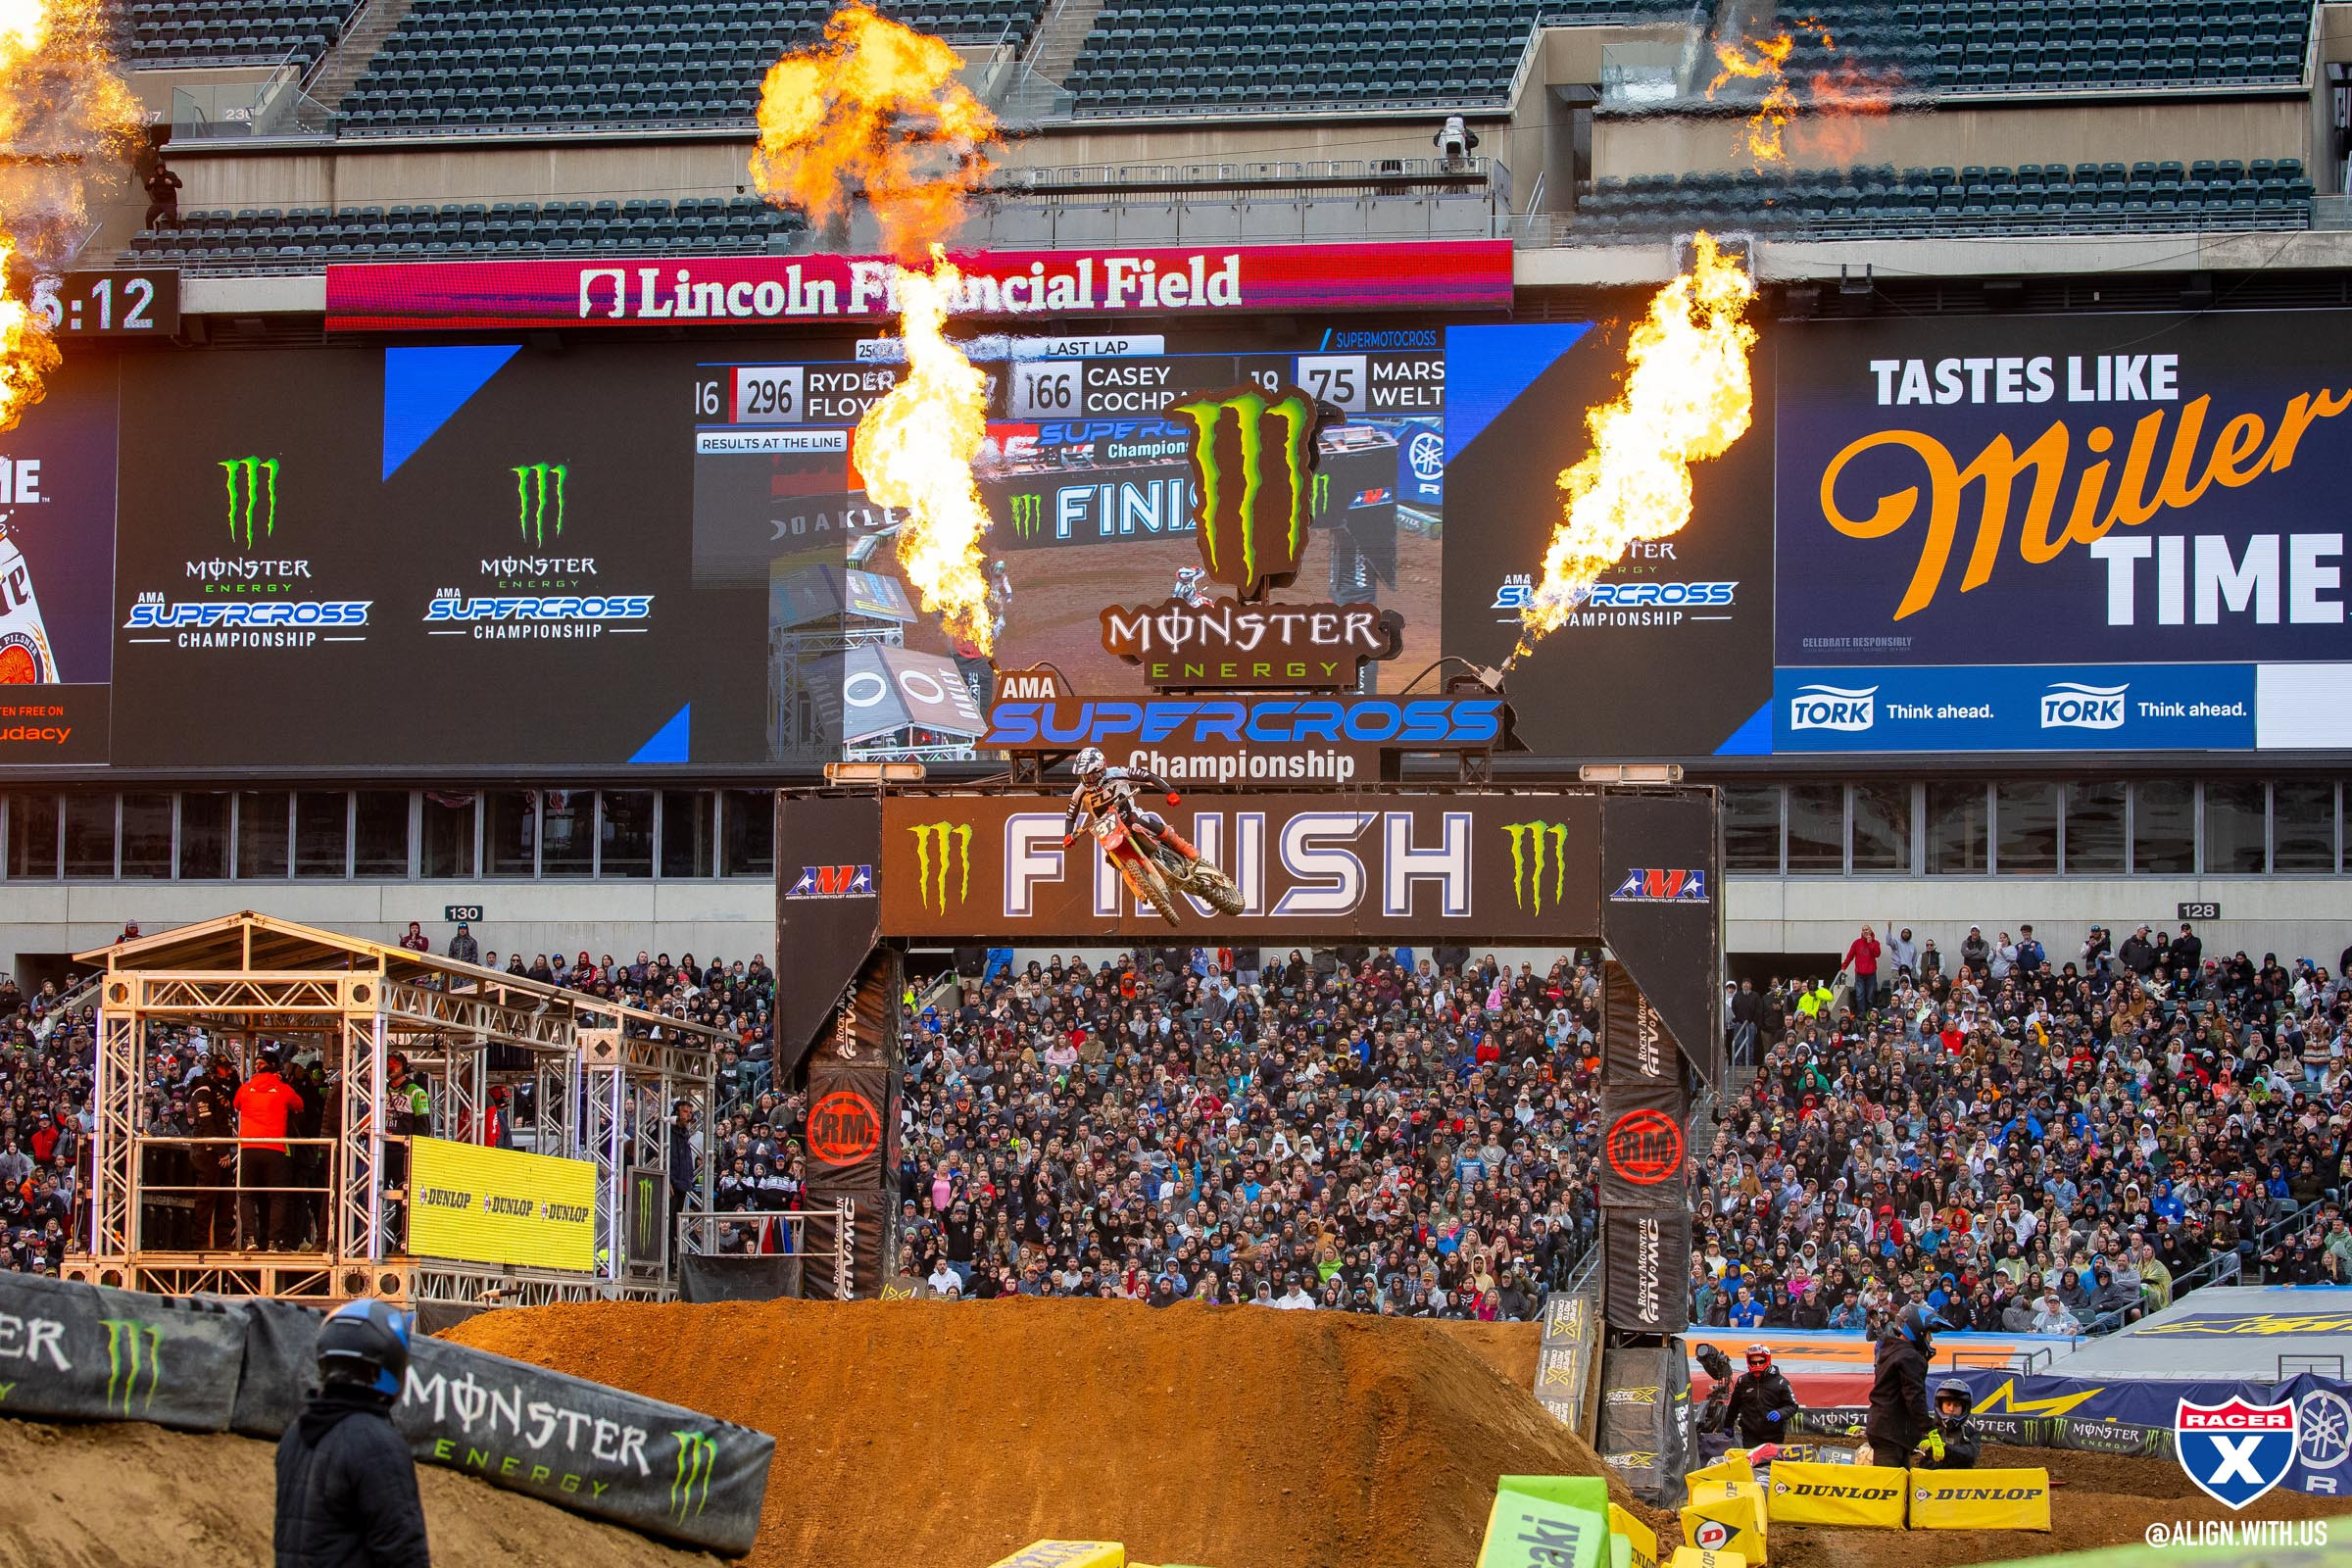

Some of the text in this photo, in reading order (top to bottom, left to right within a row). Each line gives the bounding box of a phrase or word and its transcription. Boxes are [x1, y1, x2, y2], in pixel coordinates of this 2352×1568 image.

[638, 264, 838, 318] Lincoln
[1104, 254, 1242, 309] Field
[1095, 340, 1128, 354] LAP
[1336, 331, 1437, 348] SUPERMOTOCROSS
[1087, 367, 1171, 387] CASEY
[1373, 361, 1445, 380] MARS
[1870, 354, 2179, 405] TASTES LIKE
[808, 371, 895, 393] RYDER
[1027, 373, 1072, 410] 166
[1308, 368, 1355, 404] 75
[695, 381, 719, 415] 16
[747, 379, 793, 414] 296
[1087, 391, 1188, 412] COCHR
[1372, 386, 1445, 406] WELT
[702, 436, 842, 450] RESULTS AT THE LINE
[1821, 387, 2352, 621] Miller
[186, 557, 312, 581] MONSTER
[480, 555, 598, 577] MONSTER
[206, 583, 292, 593] ENERGY
[1504, 573, 1531, 585] AMA
[2090, 532, 2345, 625] TIME
[137, 592, 166, 603] AMA
[436, 588, 461, 598] AMA
[124, 601, 372, 628] SUPERCROSS
[423, 596, 655, 621] SUPERCROSS
[178, 631, 317, 648] CHAMPIONSHIP
[474, 624, 602, 639] CHAMPIONSHIP
[1108, 608, 1383, 653] MONSTER
[1803, 636, 1913, 648] CELEBRATE RESPONSIBLY
[1152, 661, 1339, 678] ENERGY
[1002, 676, 1056, 699] AMA
[20, 706, 45, 716] FREE
[47, 706, 64, 716] ON
[1794, 701, 1867, 724] TORK
[1886, 703, 1994, 718] Think ahead.
[2045, 699, 2120, 722] TORK
[2137, 700, 2247, 716] Think ahead.
[984, 700, 1504, 743] SUPERCROSS
[1129, 750, 1354, 781] Championship
[1091, 783, 1118, 807] FLY
[1004, 810, 1473, 917] FINISH
[785, 864, 877, 896] AMA
[1609, 868, 1710, 899] AMA
[449, 907, 478, 919] 130
[2182, 905, 2215, 917] 128
[1638, 1029, 1647, 1061] ROCKY
[821, 1112, 866, 1145] RM
[1622, 1131, 1668, 1162] RM
[427, 1188, 471, 1208] DUNLOP
[491, 1196, 533, 1217] DUNLOP
[548, 1203, 589, 1223] DUNLOP
[1638, 1217, 1647, 1306] ROCKY MOUNTAIN
[402, 1364, 651, 1477] MONSTER
[2073, 1422, 2139, 1444] MONSTER
[2081, 1439, 2128, 1450] ENERGY
[434, 1438, 610, 1500] ENERGY
[1793, 1483, 1898, 1500] DUNLOP
[1935, 1489, 2043, 1500] DUNLOP
[2306, 1475, 2337, 1494] R
[1518, 1514, 1581, 1568] aki
